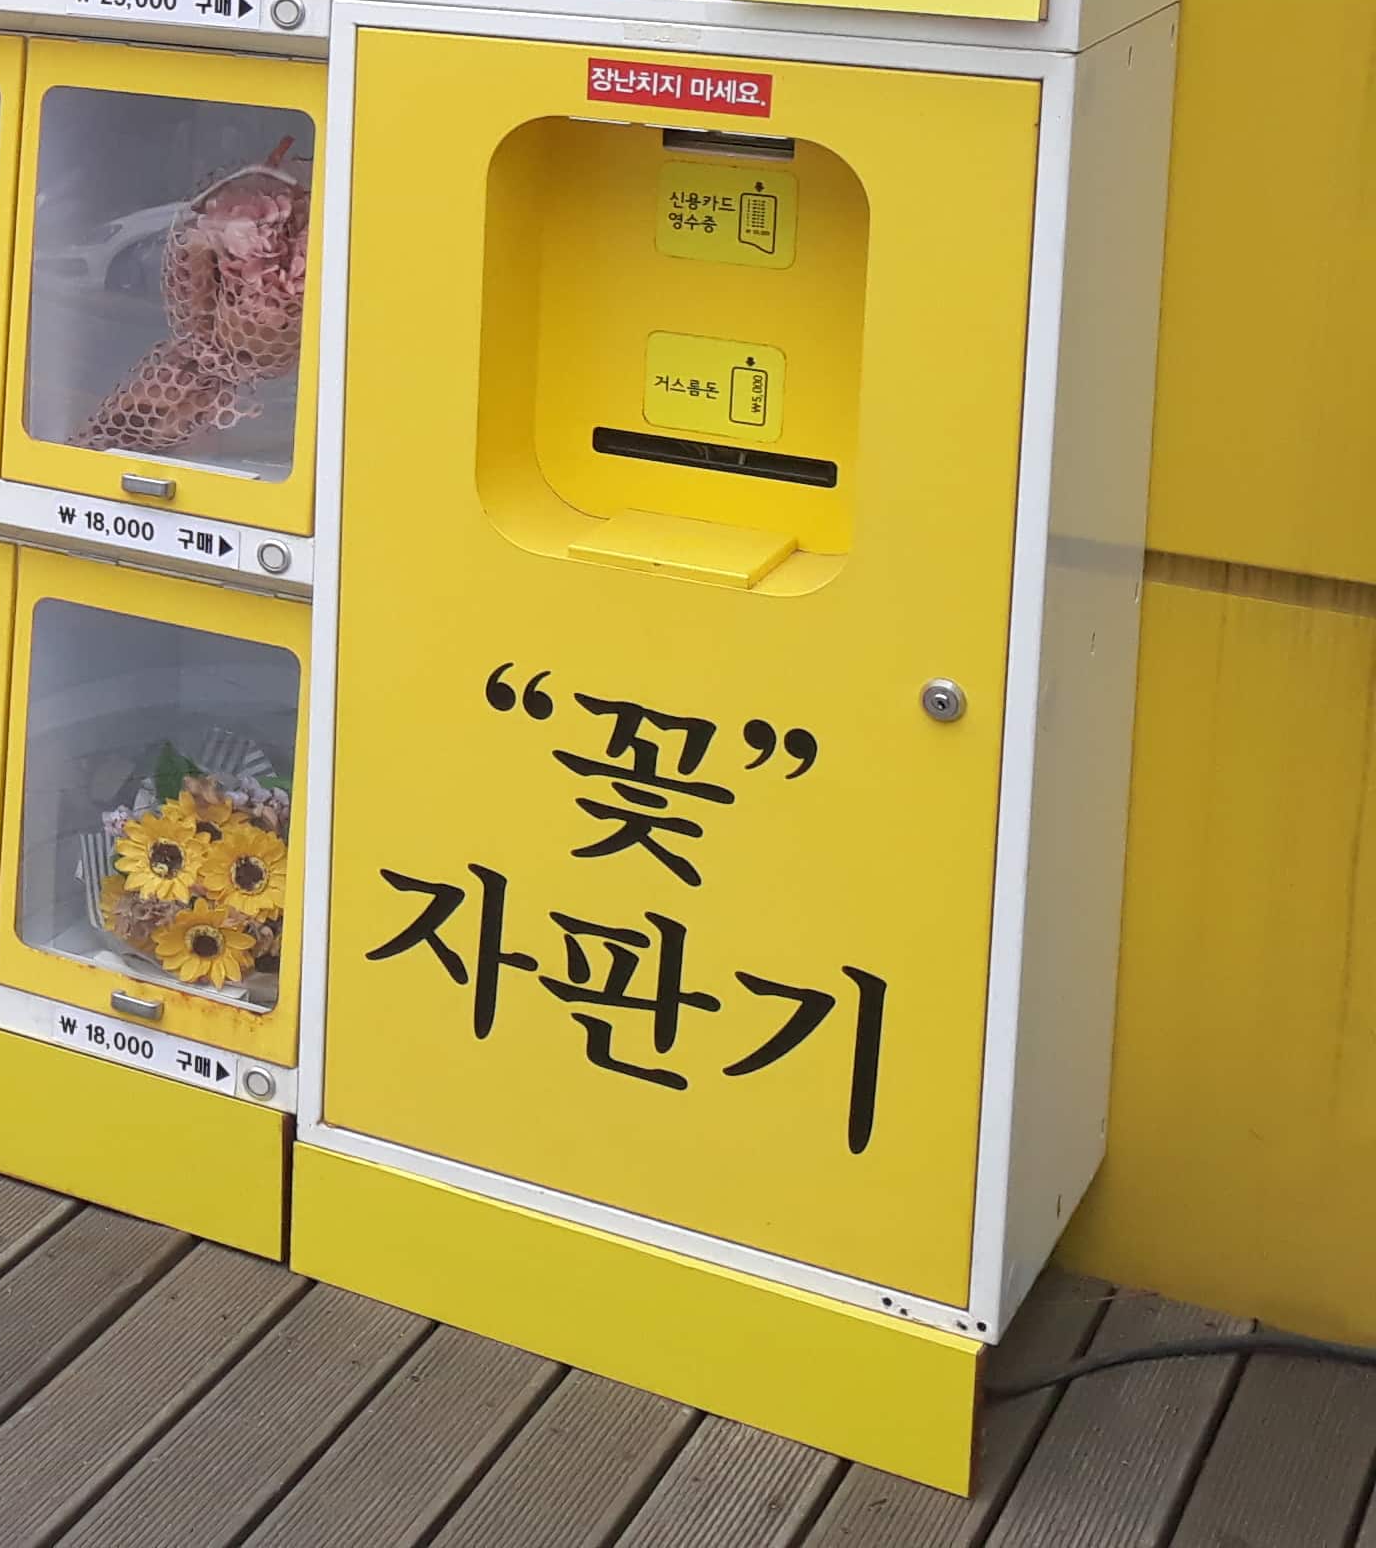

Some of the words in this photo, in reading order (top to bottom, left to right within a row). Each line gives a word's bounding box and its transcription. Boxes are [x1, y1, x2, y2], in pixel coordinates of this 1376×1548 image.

[591, 67, 682, 99] 장난치지
[690, 78, 767, 107] 마세요.
[669, 190, 736, 213] 신용카드
[668, 212, 718, 234] 영수증
[653, 374, 720, 400] 거스름돈
[59, 506, 76, 524] ₩
[85, 512, 154, 540] 18,000
[178, 529, 213, 554] 구매
[365, 863, 888, 1155] 자판기
[60, 1016, 76, 1034] ₩
[85, 1023, 154, 1060] 18,000
[176, 1050, 210, 1077] 구매
